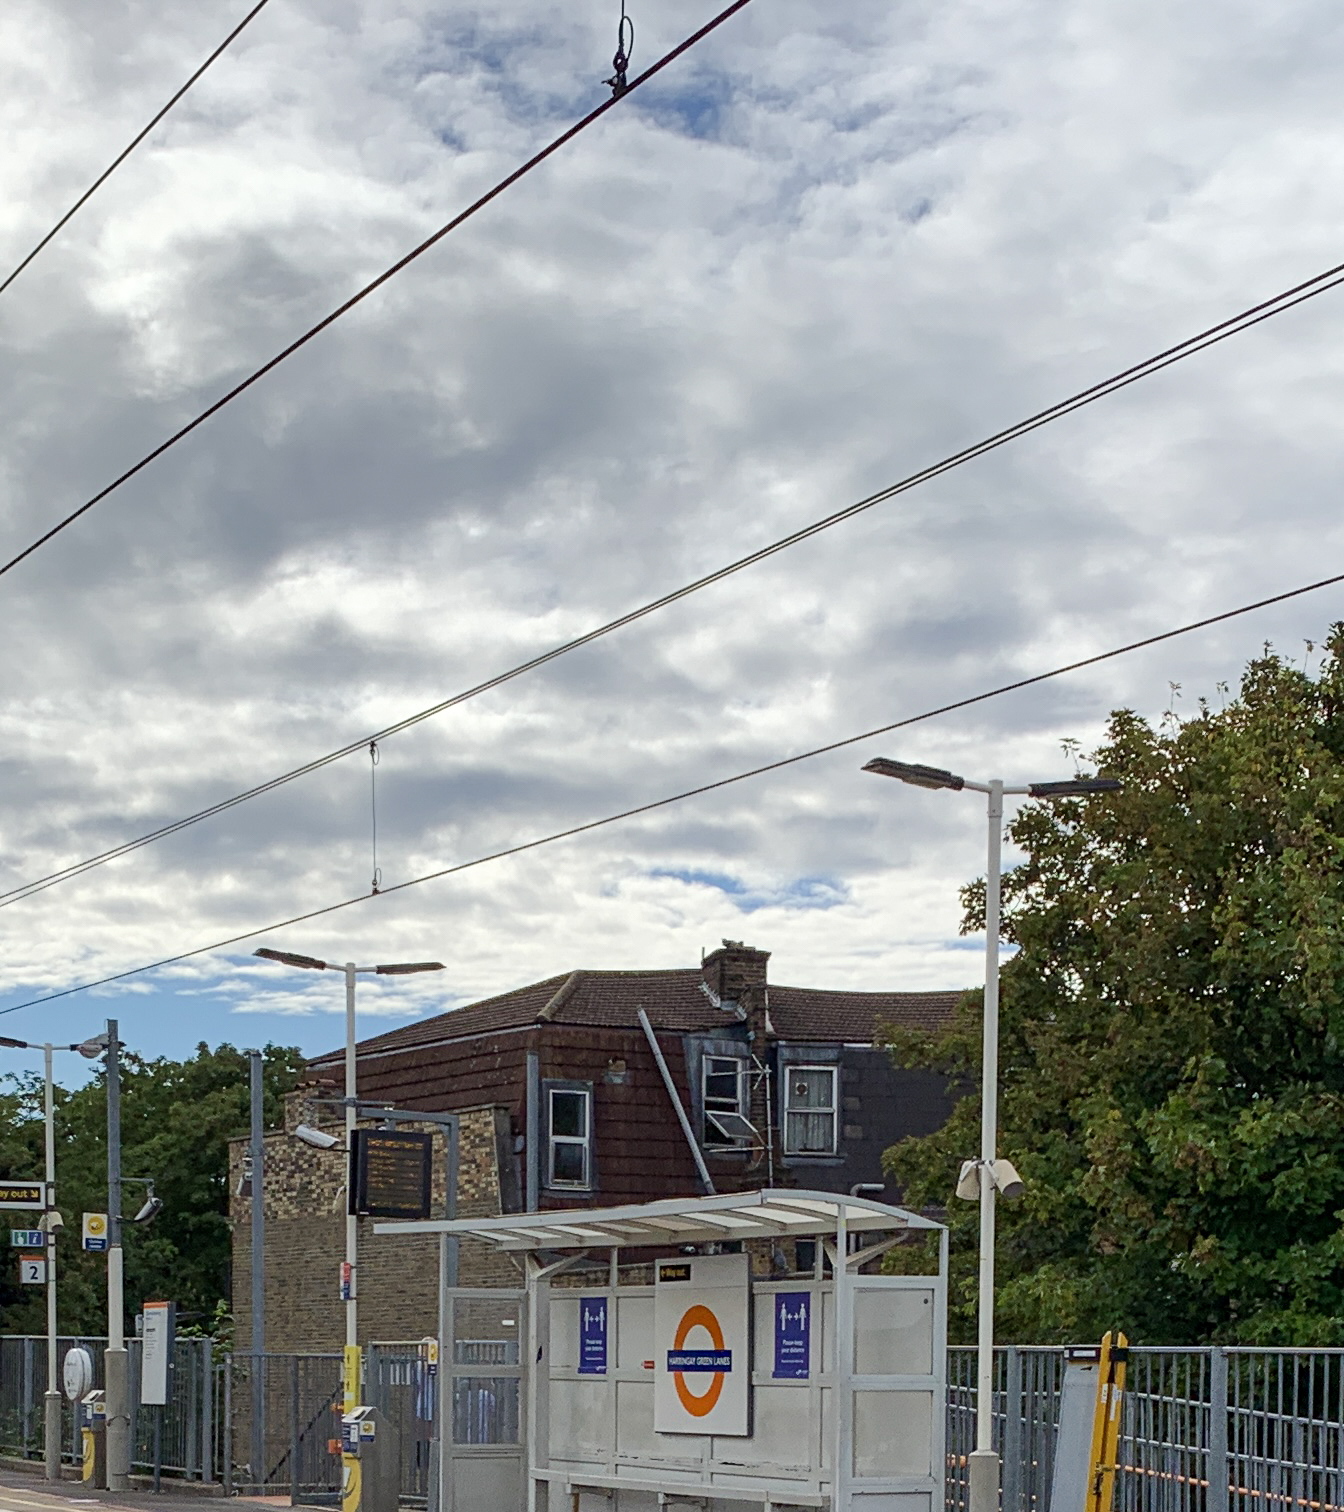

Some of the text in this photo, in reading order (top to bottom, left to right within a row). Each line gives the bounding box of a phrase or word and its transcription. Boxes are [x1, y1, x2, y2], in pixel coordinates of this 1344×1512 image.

[11, 1190, 28, 1198] out
[29, 1265, 39, 1280] 2
[696, 1356, 713, 1366] GREEN
[713, 1356, 731, 1366] LANES
